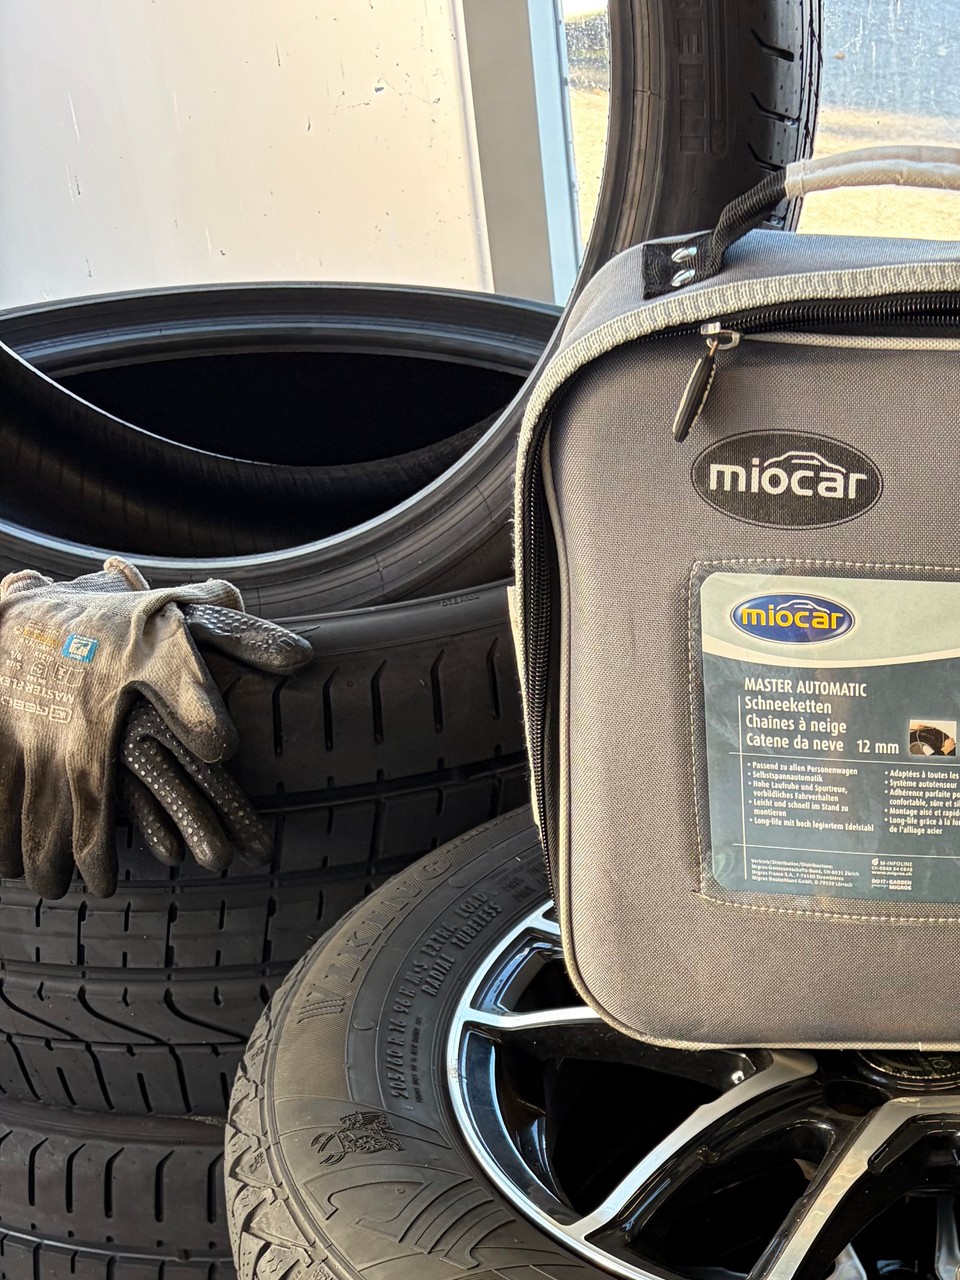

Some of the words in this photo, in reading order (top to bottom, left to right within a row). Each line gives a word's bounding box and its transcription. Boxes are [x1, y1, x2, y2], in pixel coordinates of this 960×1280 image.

[708, 456, 868, 501] miocar
[741, 607, 843, 630] miocar
[26, 683, 75, 704] MASTER
[744, 677, 792, 693] MASTER
[797, 681, 867, 697] AUTOMATIC
[745, 695, 832, 714] Schneeketten
[745, 714, 794, 730] Chaînes
[799, 717, 806, 731] à
[811, 719, 846, 736] neige
[746, 733, 789, 748] Catene
[794, 734, 808, 749] da
[813, 739, 844, 752] neve
[857, 740, 870, 753] 12
[875, 742, 899, 754] mm
[752, 761, 779, 770] Passend
[789, 763, 805, 772] allen
[807, 765, 858, 776] Personenwagen
[890, 769, 920, 779] Adaptées
[921, 770, 925, 778] à
[927, 771, 948, 779] toutes
[949, 771, 959, 779] les
[752, 771, 823, 782] Selbstspannautomatik
[890, 779, 917, 788] Système
[918, 780, 957, 788] autotenseur
[771, 782, 799, 790] Laufruhe
[801, 783, 813, 791] und
[815, 785, 848, 794] Spurtreue,
[890, 789, 923, 797] Adhérence
[925, 790, 950, 799] parfaite
[753, 790, 793, 799] vorbildliches
[795, 792, 838, 802] Fahrverhalten
[889, 798, 928, 807] confortable,
[930, 799, 943, 807] sûre
[753, 799, 772, 807] Leicht
[788, 801, 810, 809] schnell
[821, 803, 840, 811] Stand
[754, 808, 787, 817] montieren
[889, 808, 918, 817] Montage
[754, 817, 782, 827] Long-life
[784, 819, 795, 827] mit
[796, 819, 811, 827] hoch
[812, 821, 844, 830] legiertem
[845, 823, 874, 832] Edelstahl
[889, 817, 917, 826] Long-life
[919, 819, 937, 827] grâce
[899, 826, 925, 836] l'alliage
[454, 891, 489, 919] LOAD
[297, 850, 452, 1025] VIKING
[423, 922, 458, 958] EXTRA
[421, 954, 456, 997] RADIAL
[452, 901, 504, 950] TUBELESS
[389, 1019, 407, 1035] 16
[387, 1036, 405, 1047] R
[386, 1053, 410, 1100] 205/60
